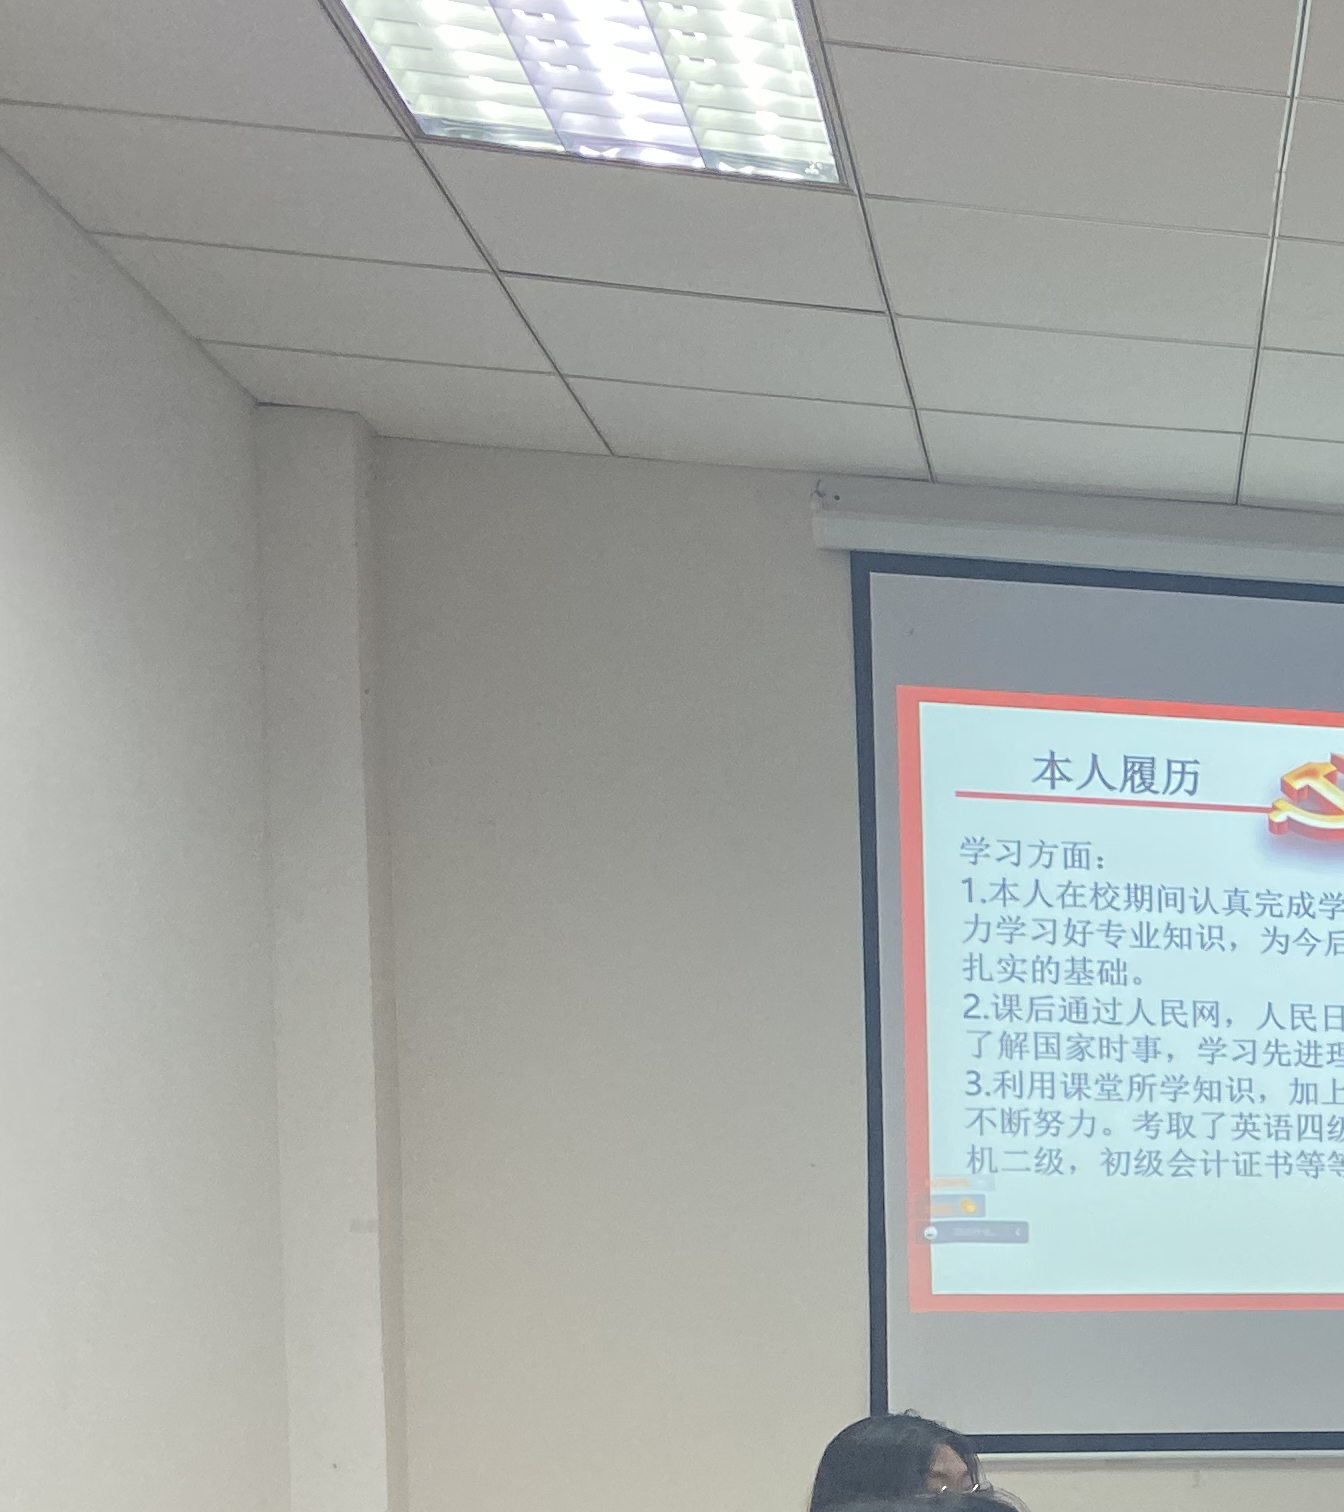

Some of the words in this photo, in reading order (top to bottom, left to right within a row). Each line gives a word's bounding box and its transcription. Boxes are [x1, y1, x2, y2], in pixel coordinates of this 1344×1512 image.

[1032, 749, 1202, 797] 本人履历
[959, 835, 1106, 871] 学习方面：
[961, 952, 1148, 988] 扎实的基础。
